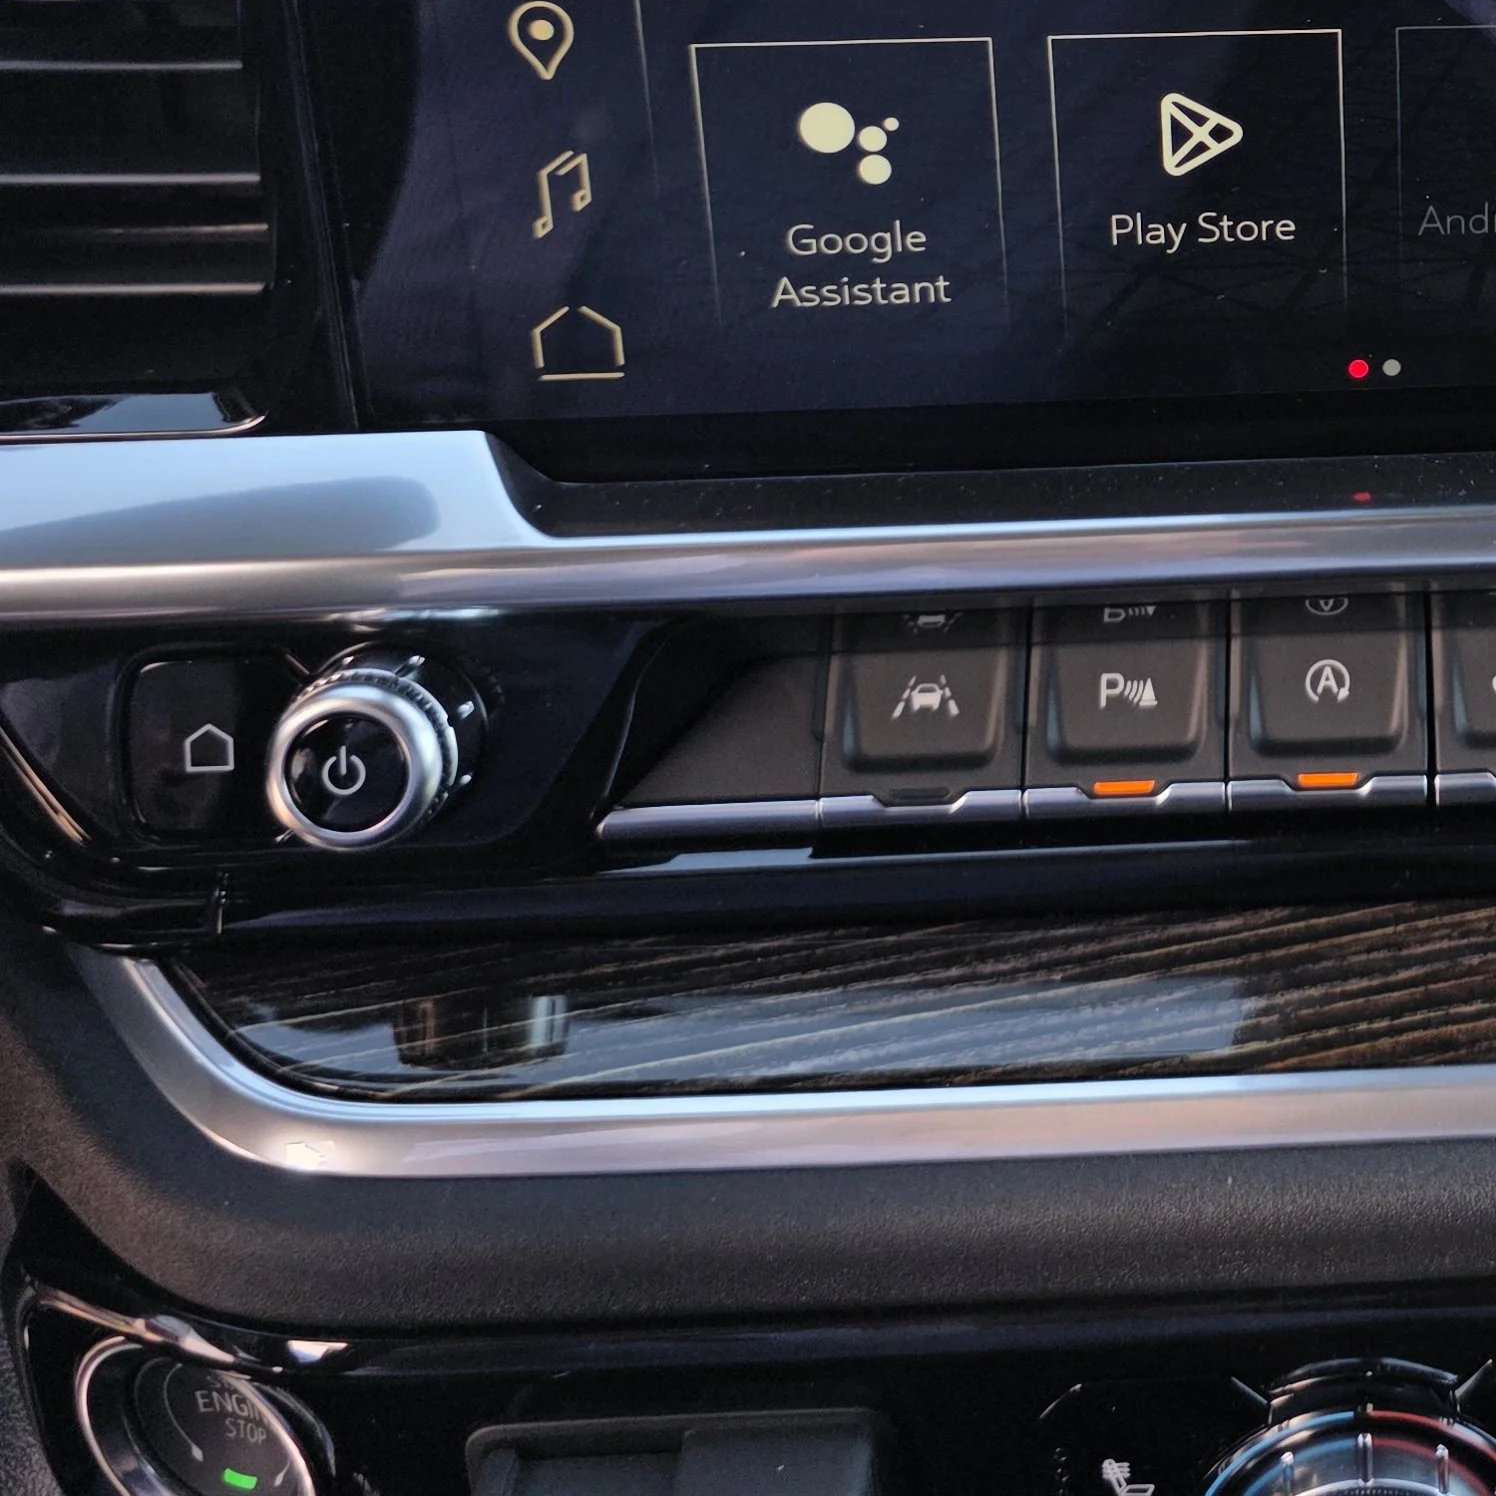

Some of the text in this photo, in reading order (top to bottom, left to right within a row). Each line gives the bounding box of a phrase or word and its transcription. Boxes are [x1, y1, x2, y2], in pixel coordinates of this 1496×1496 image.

[787, 220, 927, 263] Google
[1111, 211, 1296, 254] Play Store
[770, 274, 952, 308] Assistant
[1316, 665, 1338, 694] A
[225, 1417, 267, 1444] STOP
